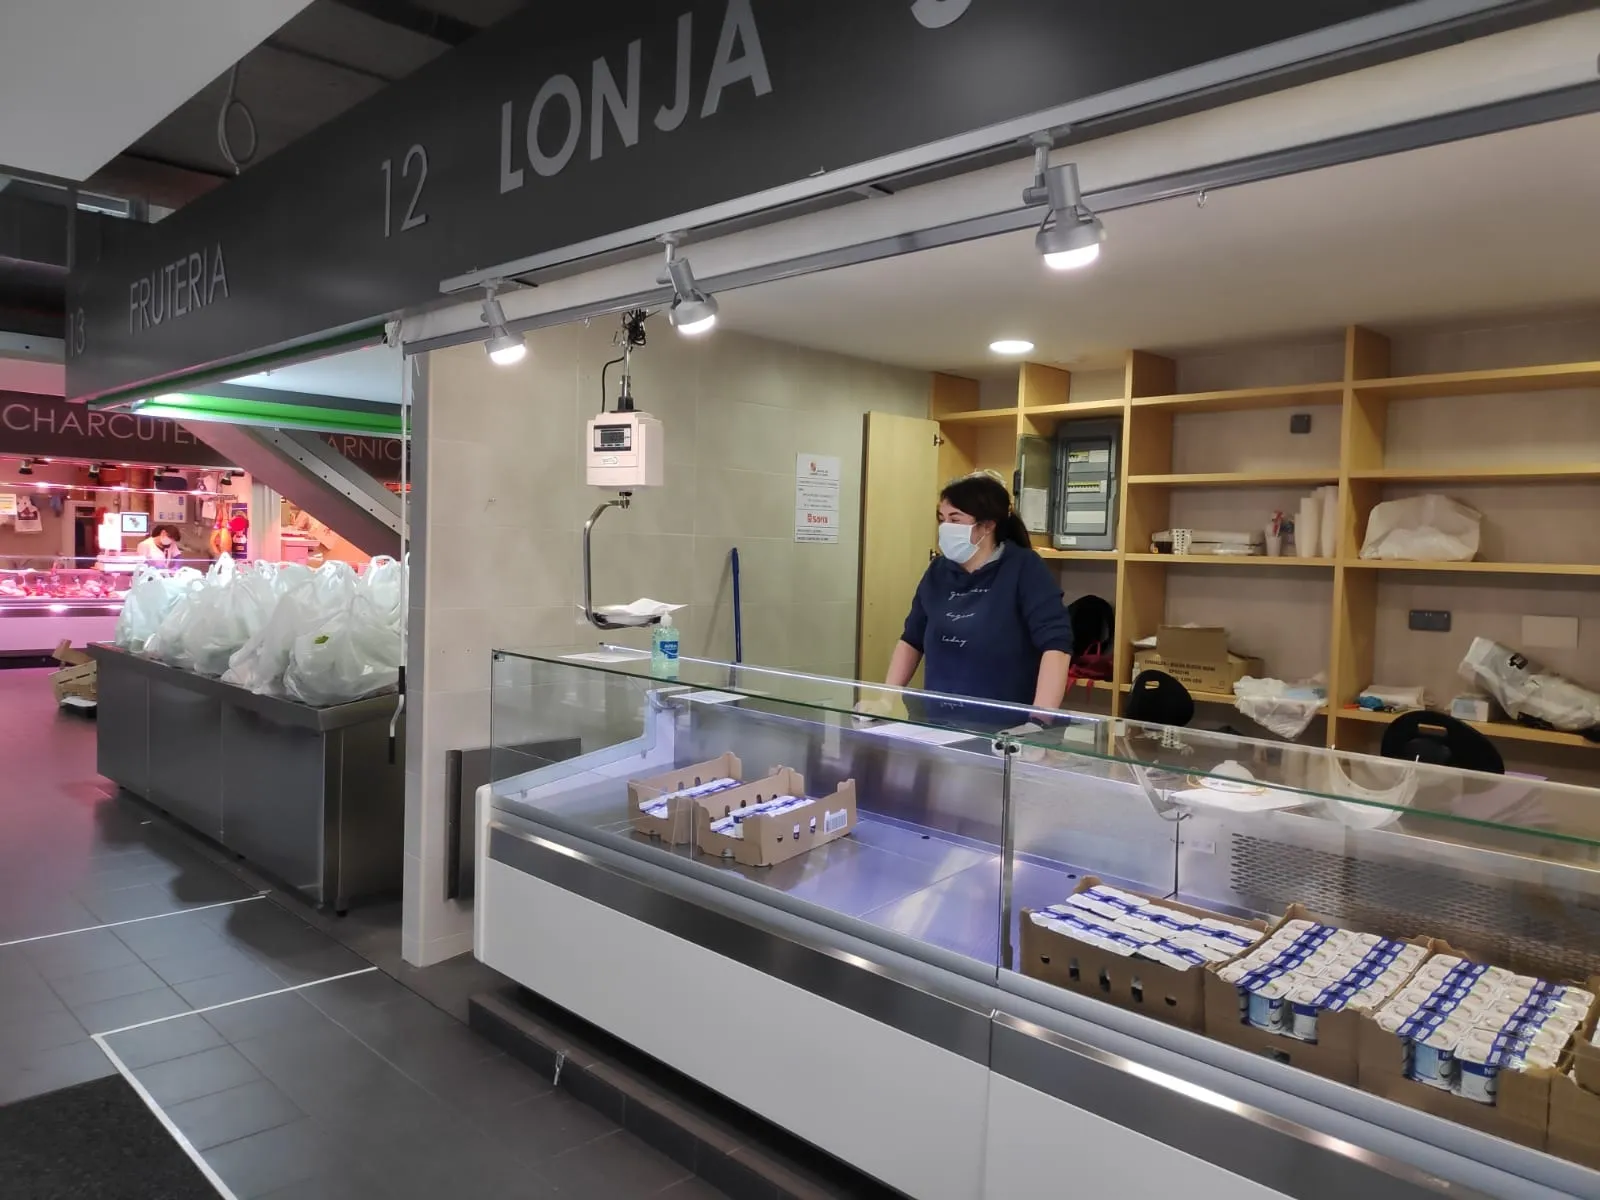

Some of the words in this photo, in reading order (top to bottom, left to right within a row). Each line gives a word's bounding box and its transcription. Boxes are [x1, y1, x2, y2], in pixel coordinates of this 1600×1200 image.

[380, 143, 429, 238] 12
[500, 0, 773, 194] LONJA
[69, 307, 86, 358] 13
[130, 243, 230, 334] FRUTERIA
[2, 403, 198, 445] CHARCUTE
